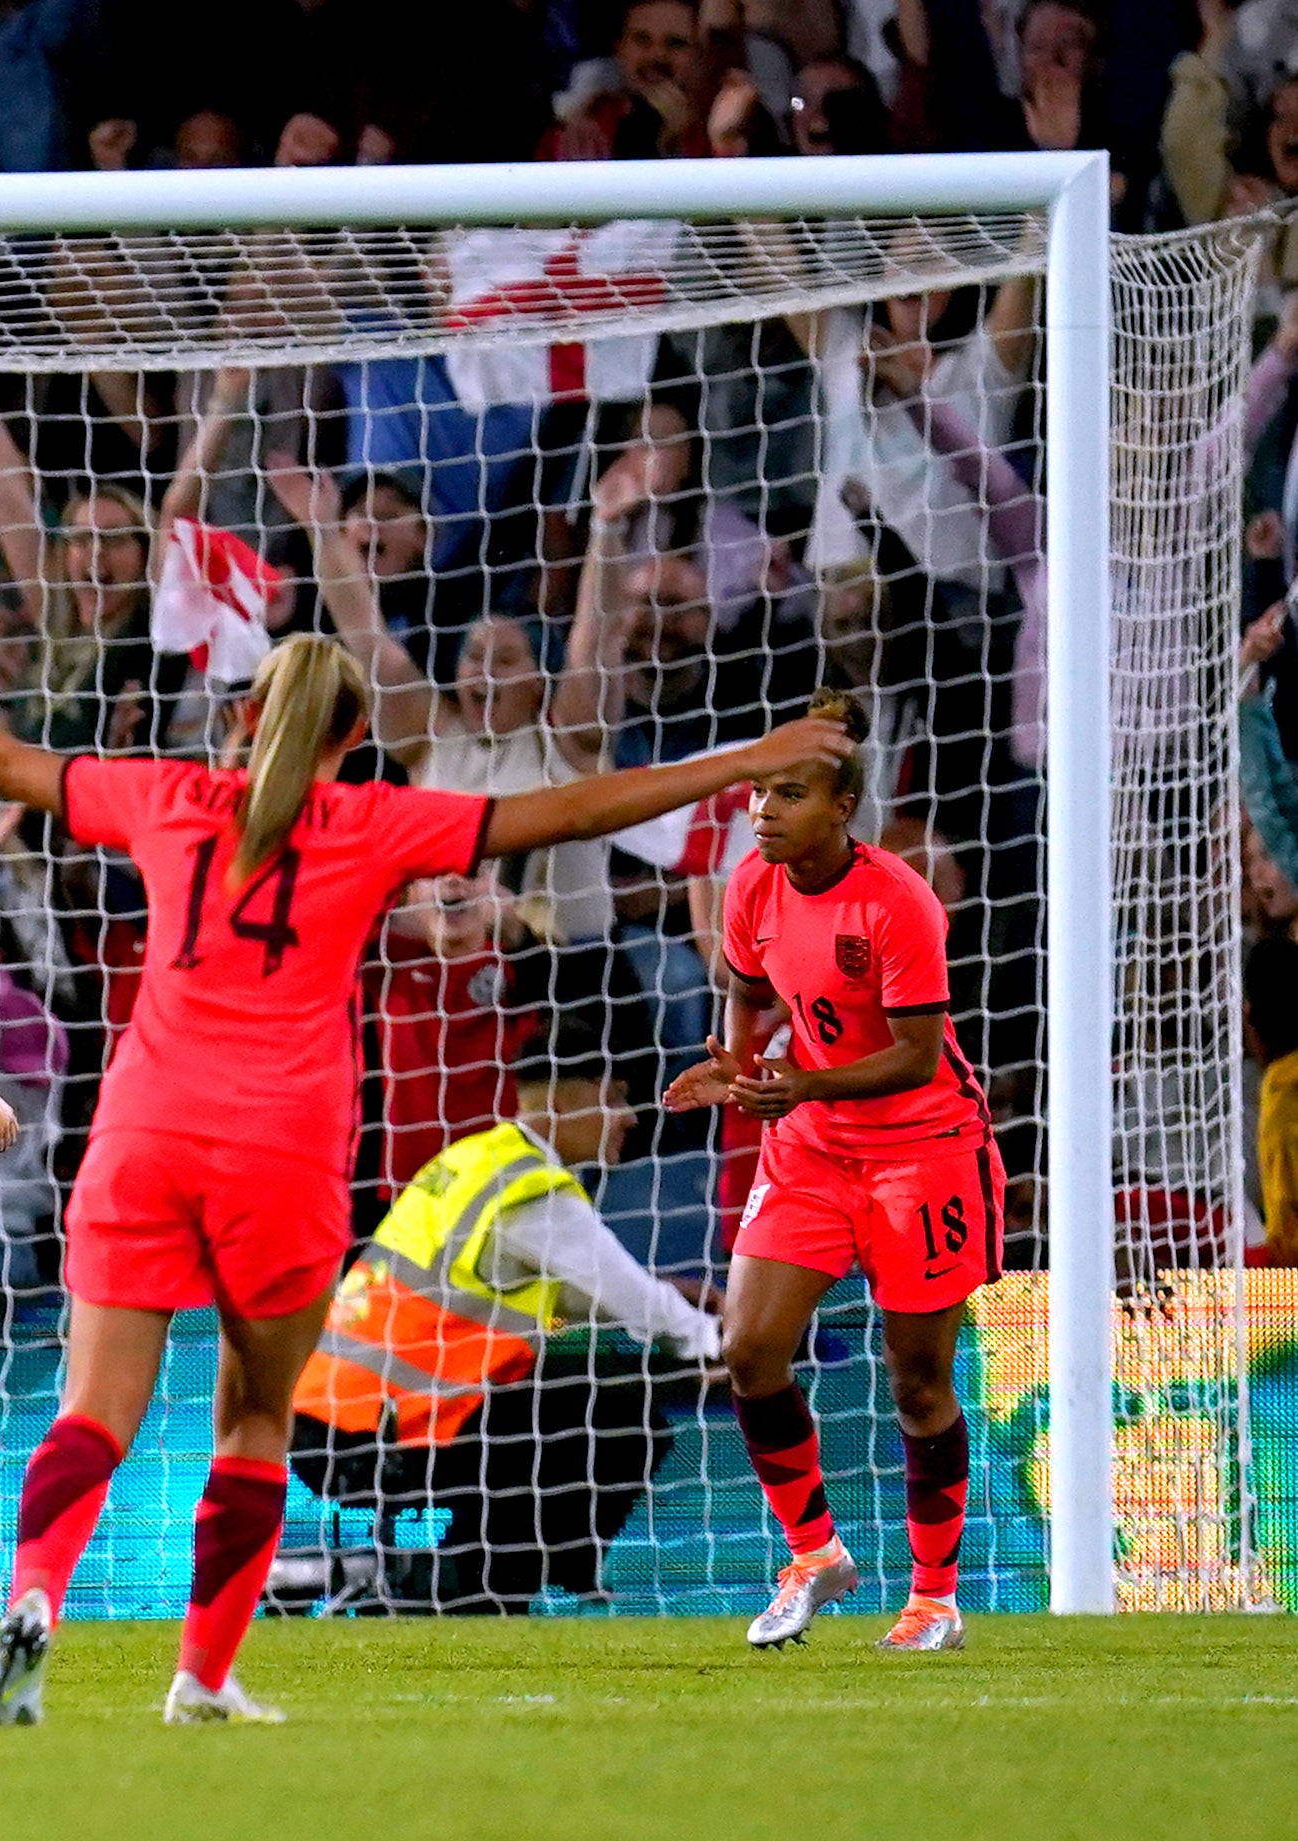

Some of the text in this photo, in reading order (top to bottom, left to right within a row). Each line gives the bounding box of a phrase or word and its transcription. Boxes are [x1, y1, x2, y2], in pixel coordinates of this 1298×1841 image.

[168, 833, 301, 979] 14
[790, 991, 844, 1045] 18
[916, 1194, 968, 1261] 18
